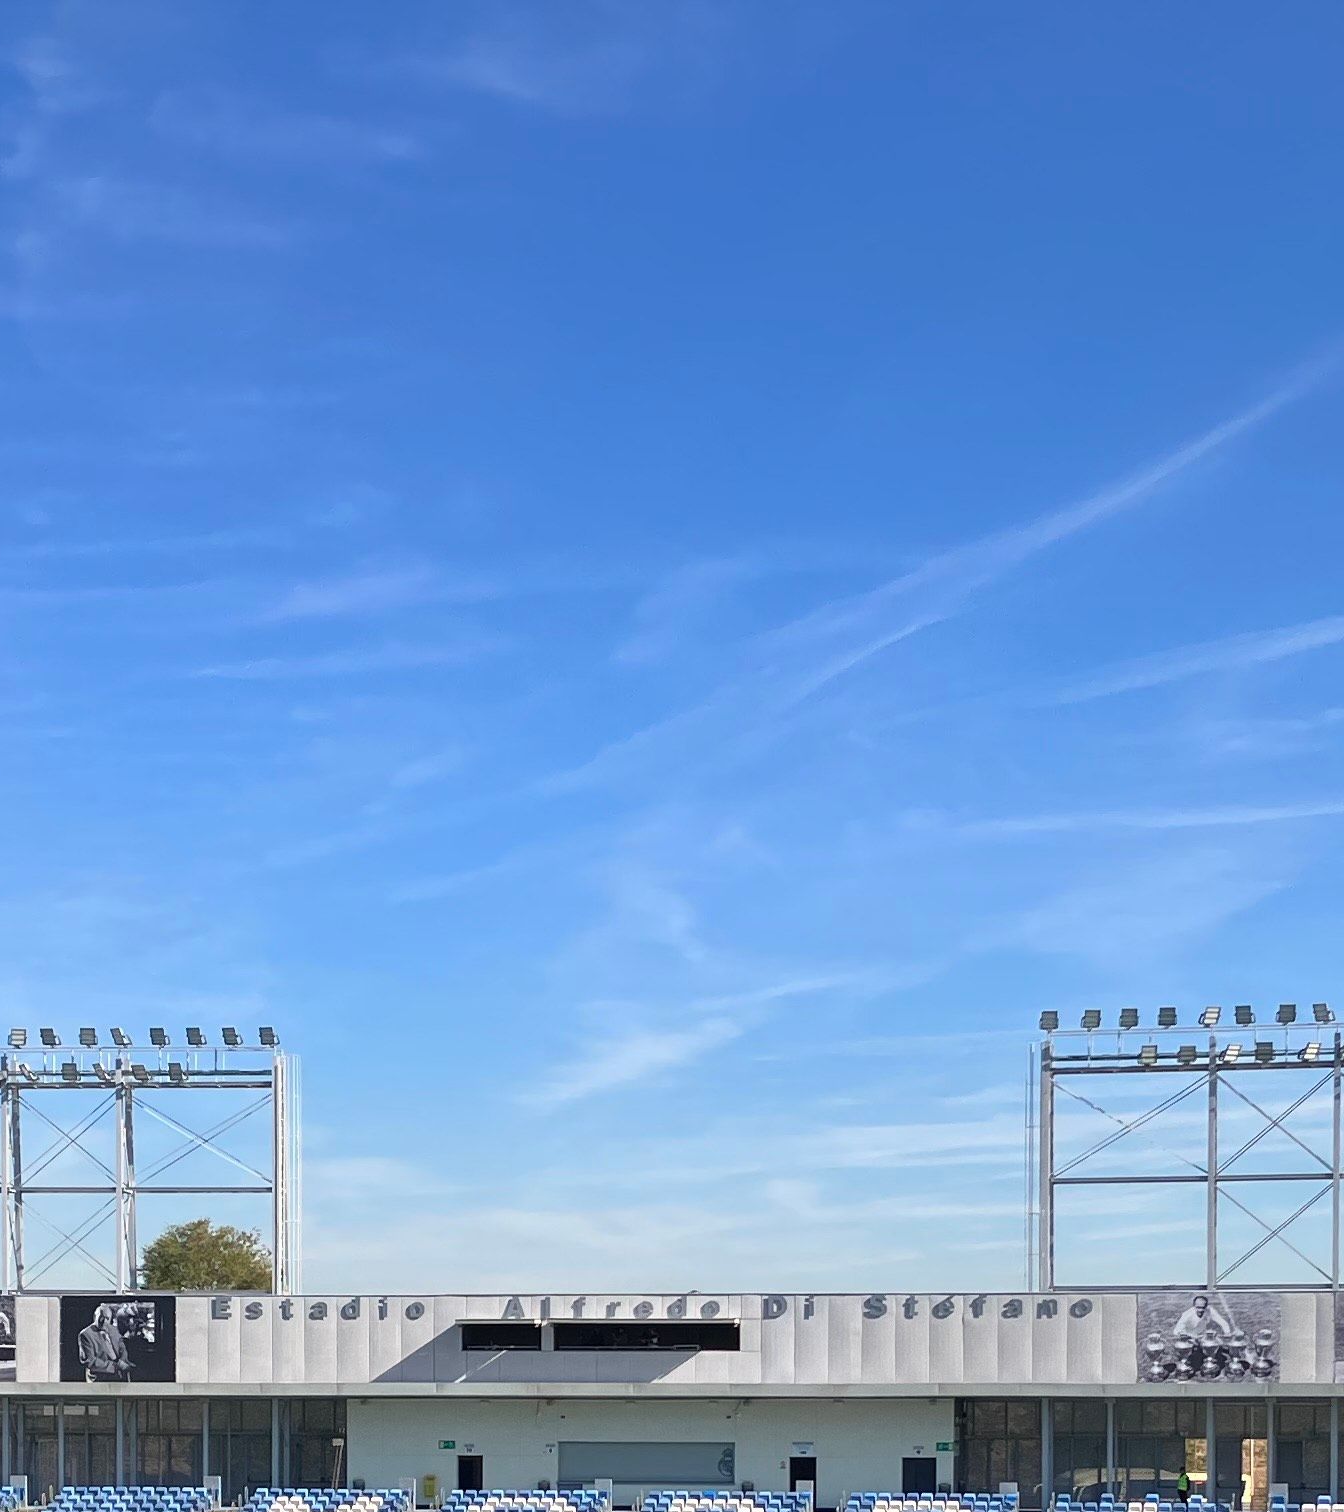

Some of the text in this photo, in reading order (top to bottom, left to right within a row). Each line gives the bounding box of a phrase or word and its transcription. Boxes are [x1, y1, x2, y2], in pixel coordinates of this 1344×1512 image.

[211, 1296, 425, 1320] Estadio
[501, 1295, 720, 1319] Alfredo
[763, 1295, 815, 1320] Di
